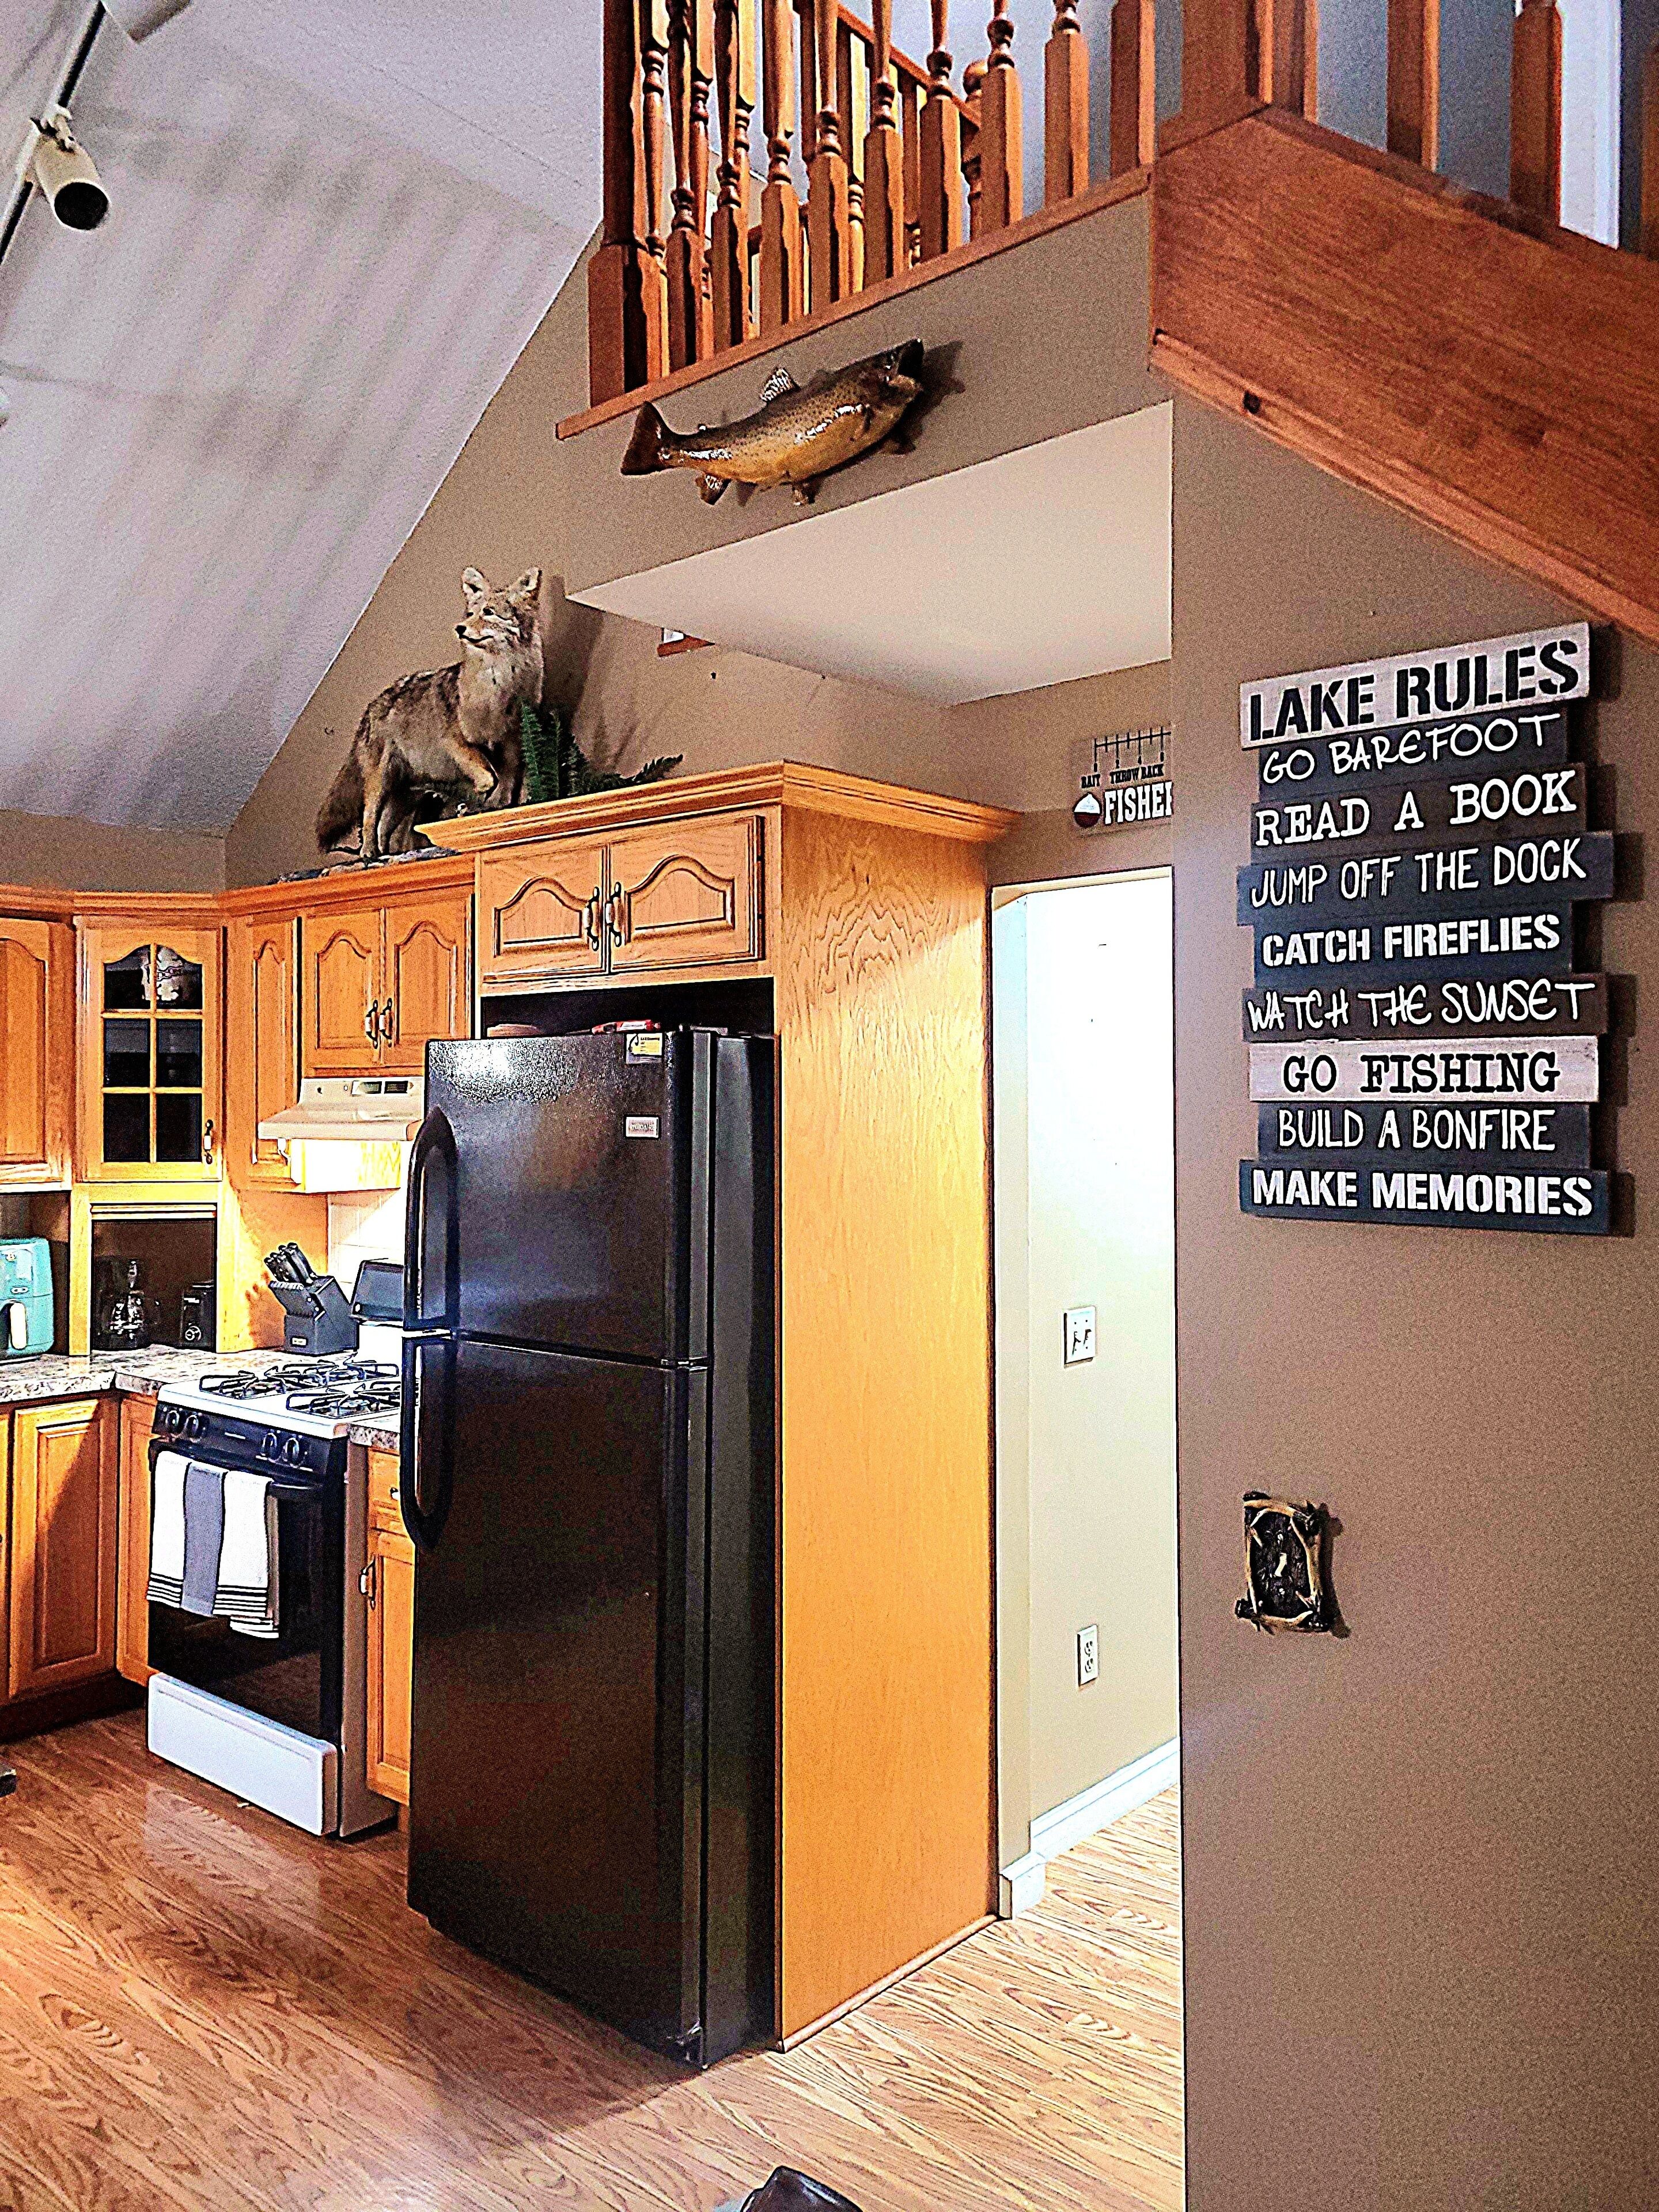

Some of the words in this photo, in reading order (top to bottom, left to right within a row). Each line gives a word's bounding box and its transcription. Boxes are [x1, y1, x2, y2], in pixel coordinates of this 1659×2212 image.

[1249, 675, 1374, 741] LAKE
[1396, 639, 1580, 718] RULES
[1109, 767, 1139, 784] THROW
[1141, 764, 1164, 779] BACK
[1262, 751, 1315, 784] GO
[1330, 714, 1560, 774] BAREFOOT
[1255, 798, 1370, 846] READ
[1394, 791, 1423, 830] A
[1450, 770, 1577, 825] BOOK
[1251, 864, 1327, 907] JUMP
[1340, 855, 1402, 899] OFF
[1415, 848, 1479, 893] THE
[1493, 838, 1586, 886] DOCK
[1262, 928, 1370, 966] CATCH
[1384, 914, 1560, 960] FIREFLIES
[1247, 988, 1349, 1032] WATCH
[1358, 985, 1432, 1027] THE
[1441, 979, 1595, 1023] SUNSET
[1283, 1055, 1337, 1093] GO
[1360, 1051, 1560, 1093] FISHING
[1278, 1109, 1364, 1148] BUILD
[1377, 1109, 1401, 1149] A
[1412, 1109, 1556, 1151] BONFIRE
[1252, 1170, 1358, 1207] MAKE
[1372, 1171, 1593, 1217] MEMORIES
